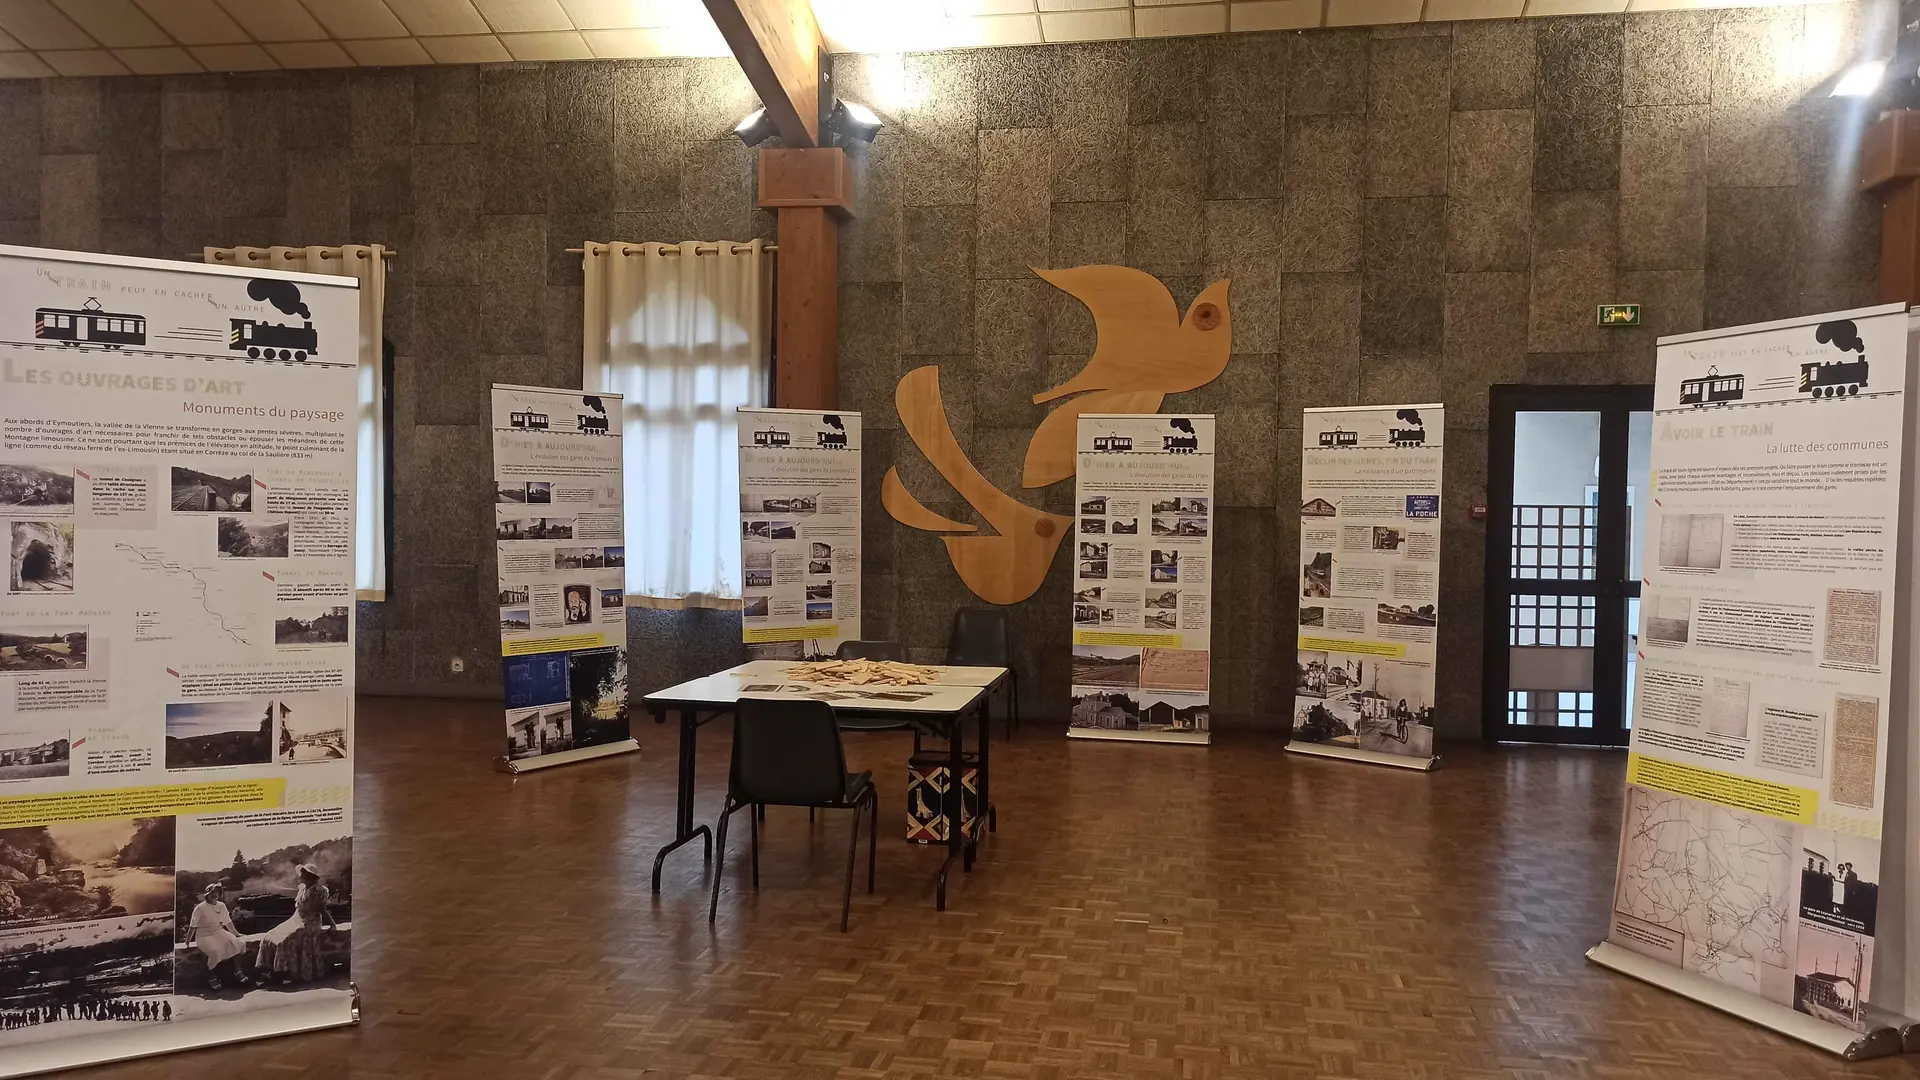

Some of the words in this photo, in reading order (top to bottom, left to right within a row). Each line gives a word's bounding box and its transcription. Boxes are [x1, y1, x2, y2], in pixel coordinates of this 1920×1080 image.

[36, 267, 51, 278] UN
[56, 277, 111, 291] TRAIN
[121, 286, 148, 295] PEUT
[154, 289, 168, 297] EN
[174, 290, 213, 300] CACHER
[234, 304, 265, 313] AUTRE
[1695, 349, 1726, 361] TRAIN
[1764, 344, 1791, 353] CACHER
[4, 358, 52, 385] LES
[59, 371, 178, 392] OUVRAGES
[184, 378, 246, 395] D'ART
[183, 401, 266, 418] Monuments
[269, 405, 287, 418] du
[290, 408, 345, 422] paysage
[4, 425, 32, 433] nombre
[35, 426, 73, 436] d'ouvrages
[95, 429, 133, 437] nécessaires
[153, 431, 179, 439] franchir
[206, 433, 236, 441] obstacles
[249, 435, 274, 444] épouser
[287, 436, 317, 444] méandres
[46, 419, 93, 429] d'Eymoutiers,
[102, 421, 122, 429] vallée
[175, 424, 211, 432] transforme
[222, 427, 243, 435] gorges
[257, 427, 278, 436] pentes
[279, 428, 303, 437] sévères,
[304, 429, 338, 439] multipliant
[1660, 422, 1704, 443] AVOIR
[1709, 425, 1725, 439] LE
[1730, 422, 1774, 438] TRAIN
[4, 433, 39, 443] Montagne
[97, 436, 112, 444] sont
[113, 437, 142, 446] pourtant
[167, 439, 196, 448] prémices
[206, 440, 239, 448] l'élévation
[249, 442, 275, 451] altitude,
[282, 443, 298, 452] point
[299, 444, 329, 452] culminant
[4, 441, 22, 450] ligne
[23, 442, 52, 451] (comme
[63, 443, 87, 451] réseau
[160, 446, 178, 454] étant
[1766, 443, 1777, 454] La
[1779, 442, 1804, 454] lutte
[1806, 441, 1825, 453] des
[1826, 440, 1889, 452] communes
